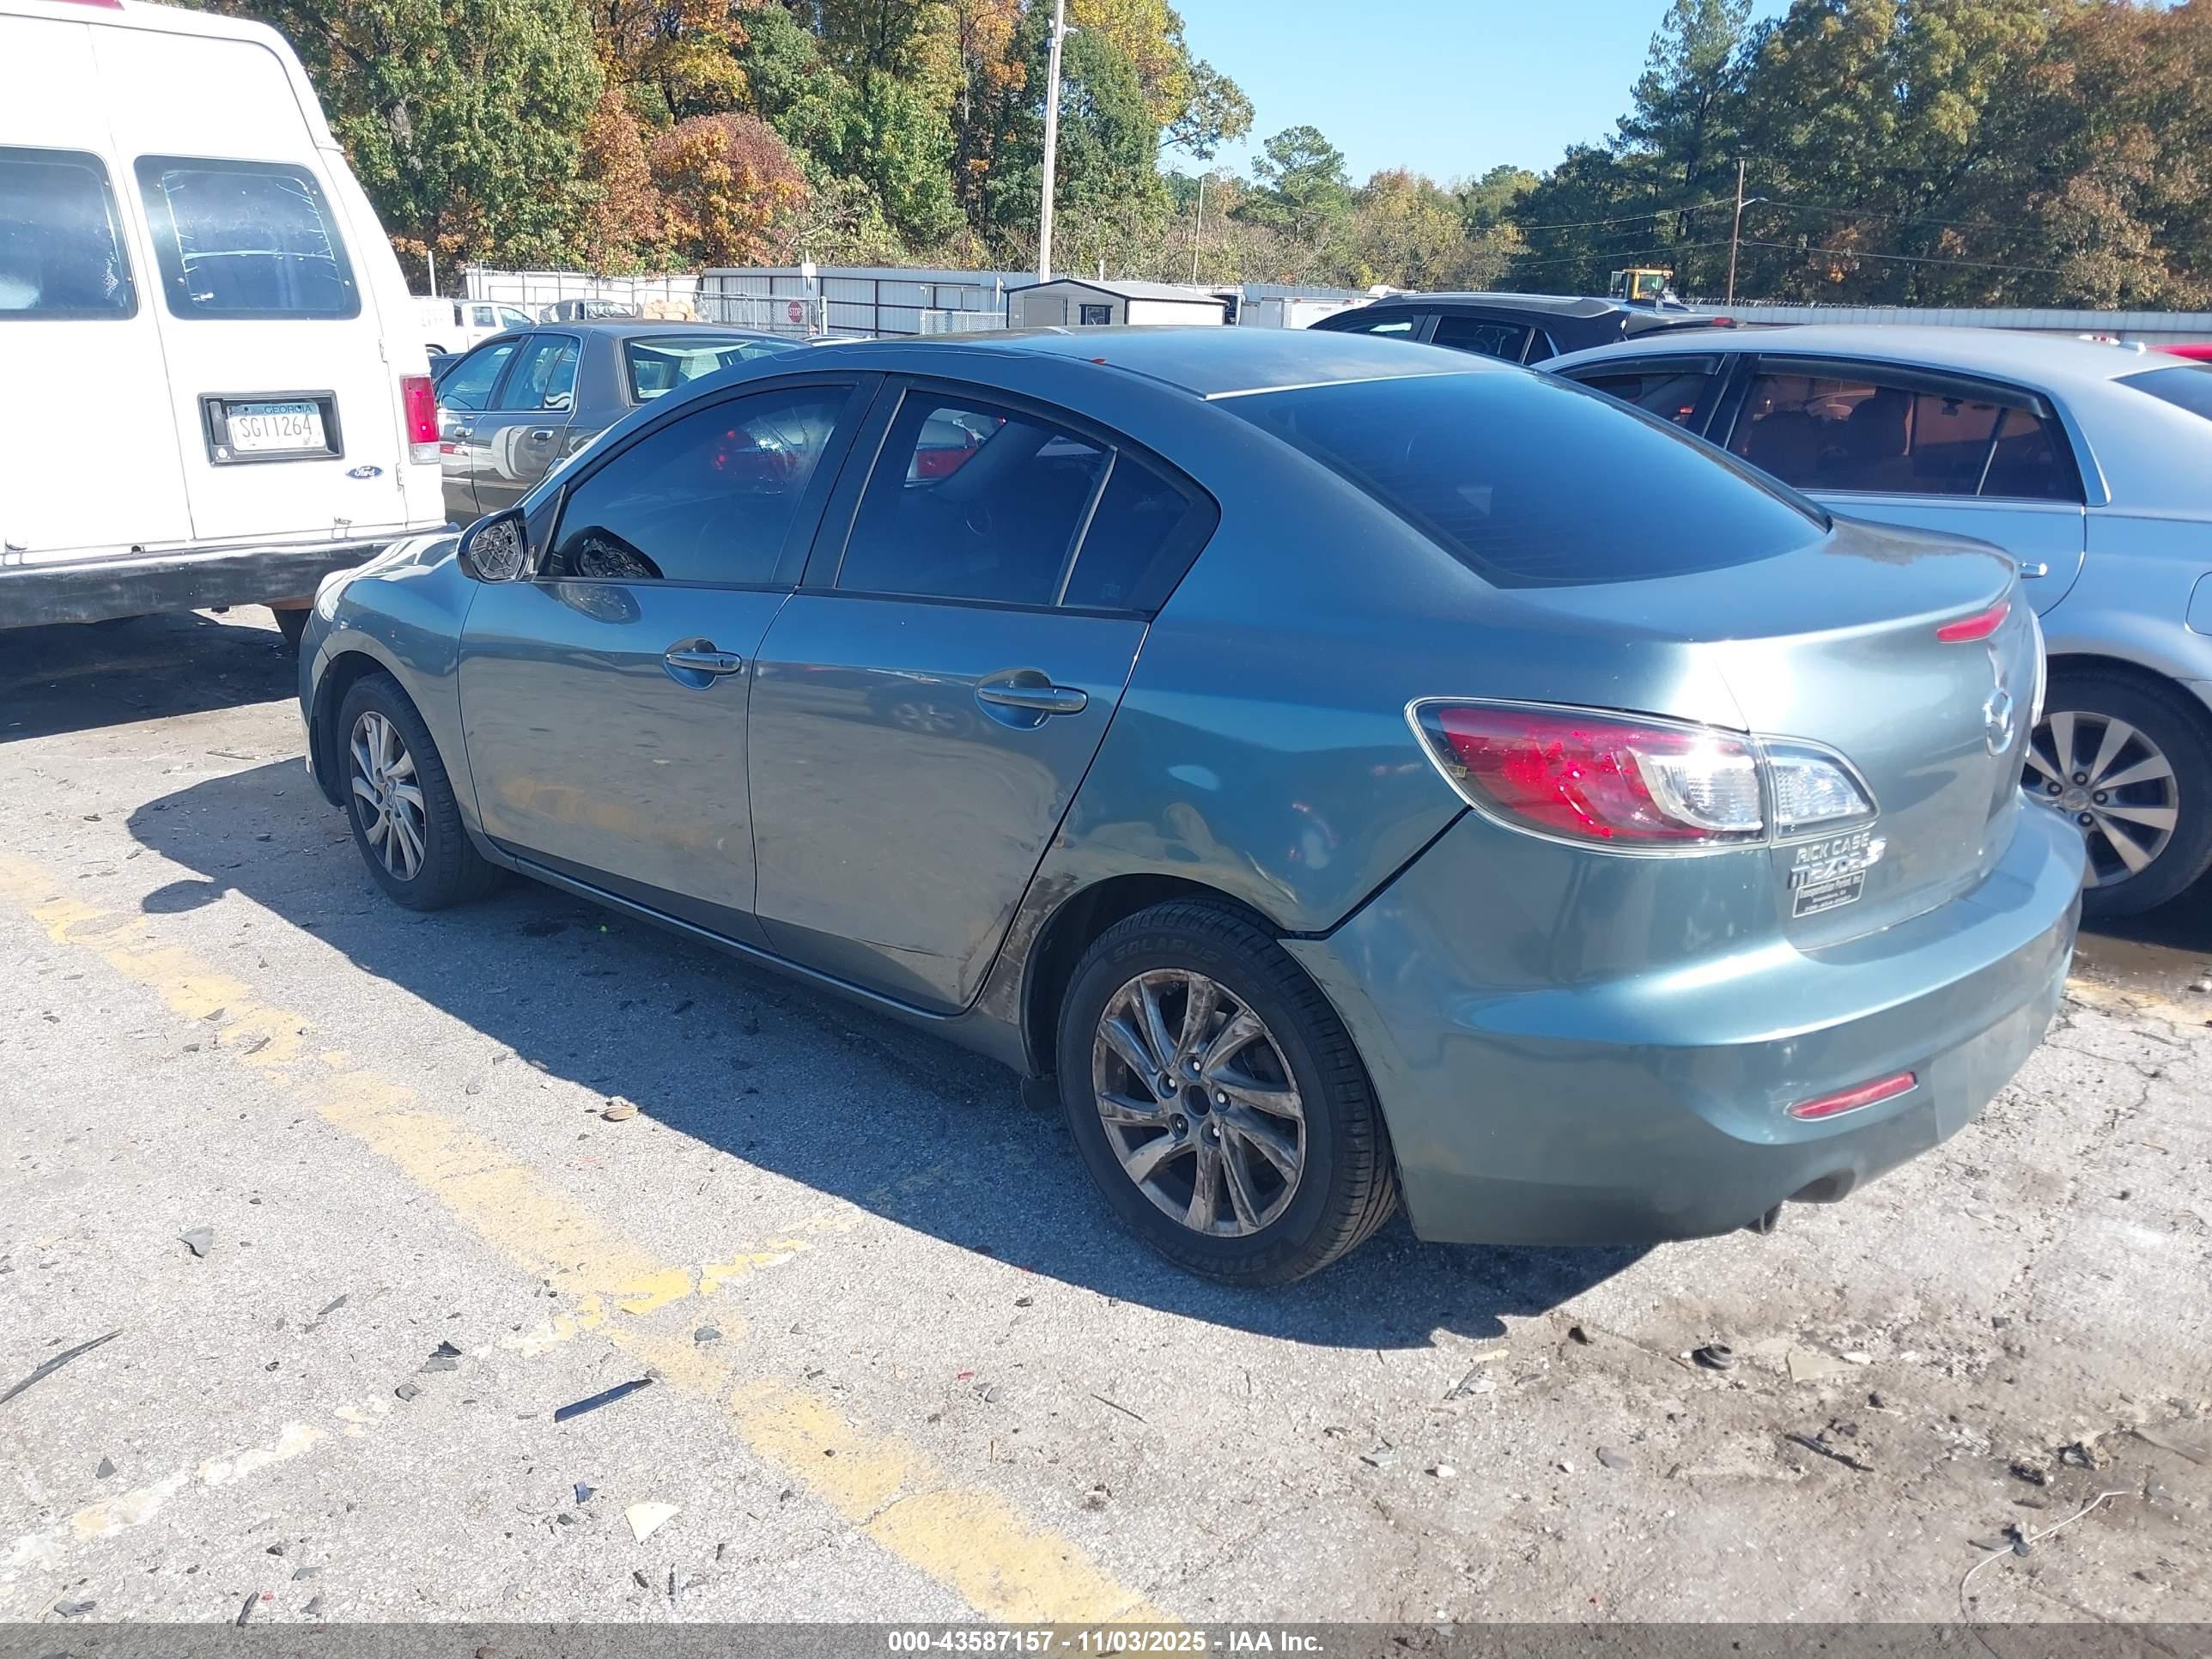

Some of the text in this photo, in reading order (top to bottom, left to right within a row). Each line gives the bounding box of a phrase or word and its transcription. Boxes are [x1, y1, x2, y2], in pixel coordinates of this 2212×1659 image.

[788, 307, 802, 317] STOP
[263, 404, 313, 415] GEORGIA
[1796, 832, 1870, 864] RICK CASE
